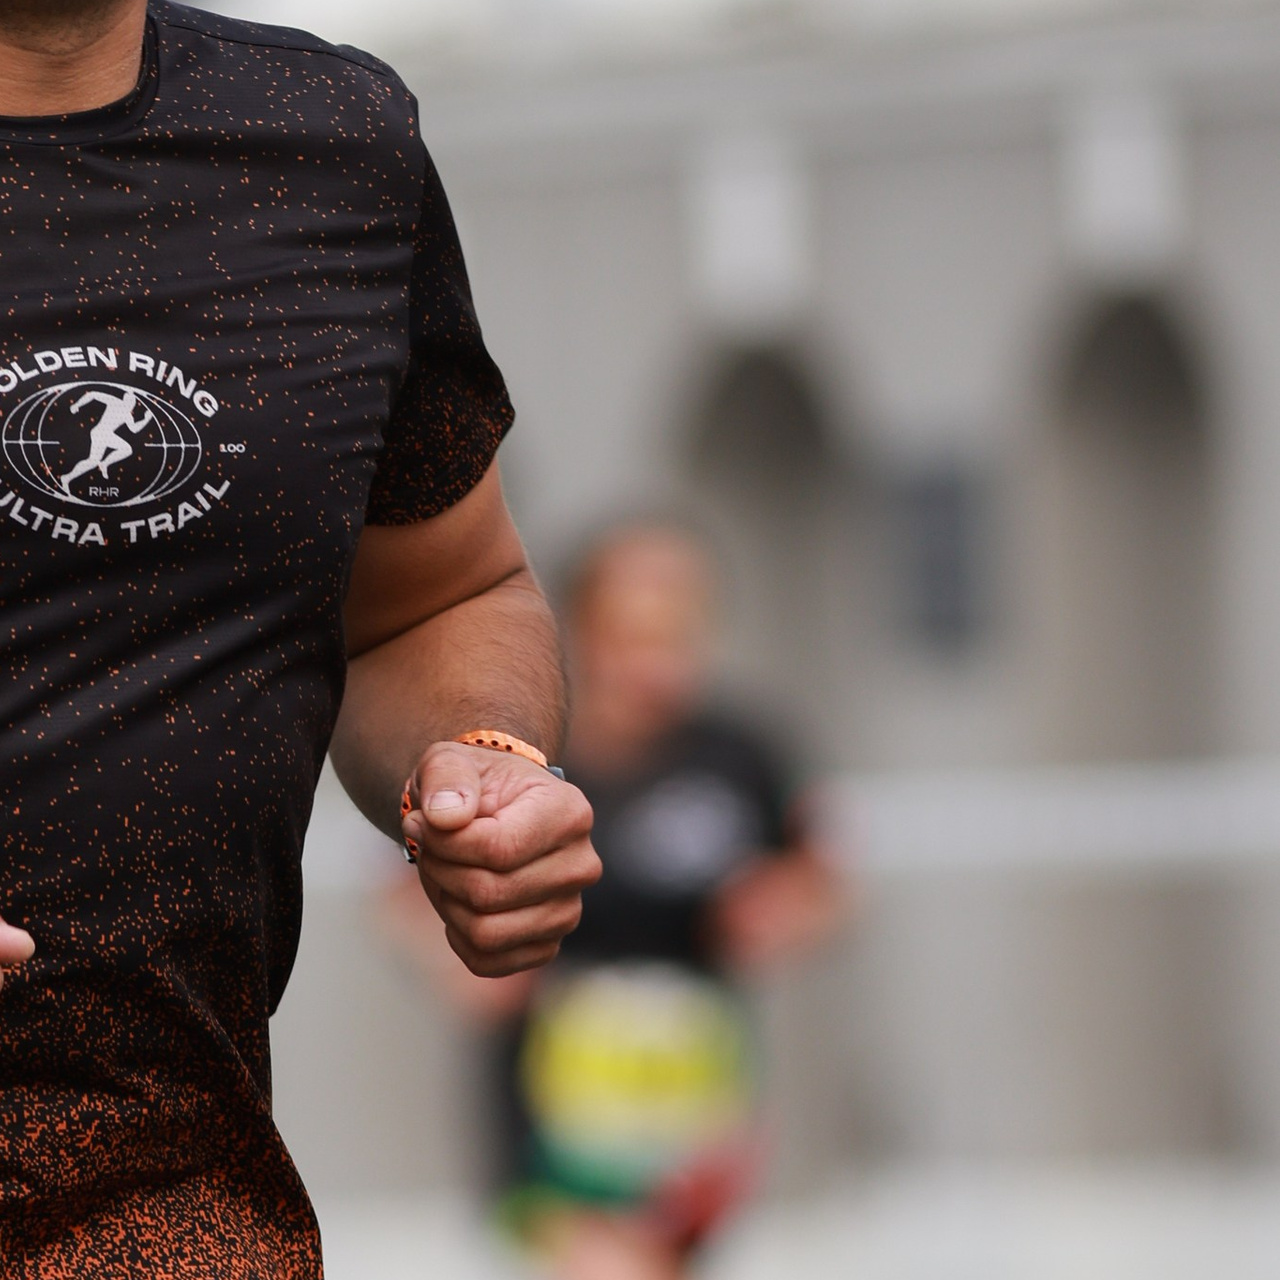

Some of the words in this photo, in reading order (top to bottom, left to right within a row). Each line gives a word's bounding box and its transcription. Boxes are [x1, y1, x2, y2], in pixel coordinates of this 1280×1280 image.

[128, 351, 219, 418] RING
[219, 443, 246, 453] 100
[88, 486, 120, 498] RHR
[120, 479, 231, 543] TRAIL
